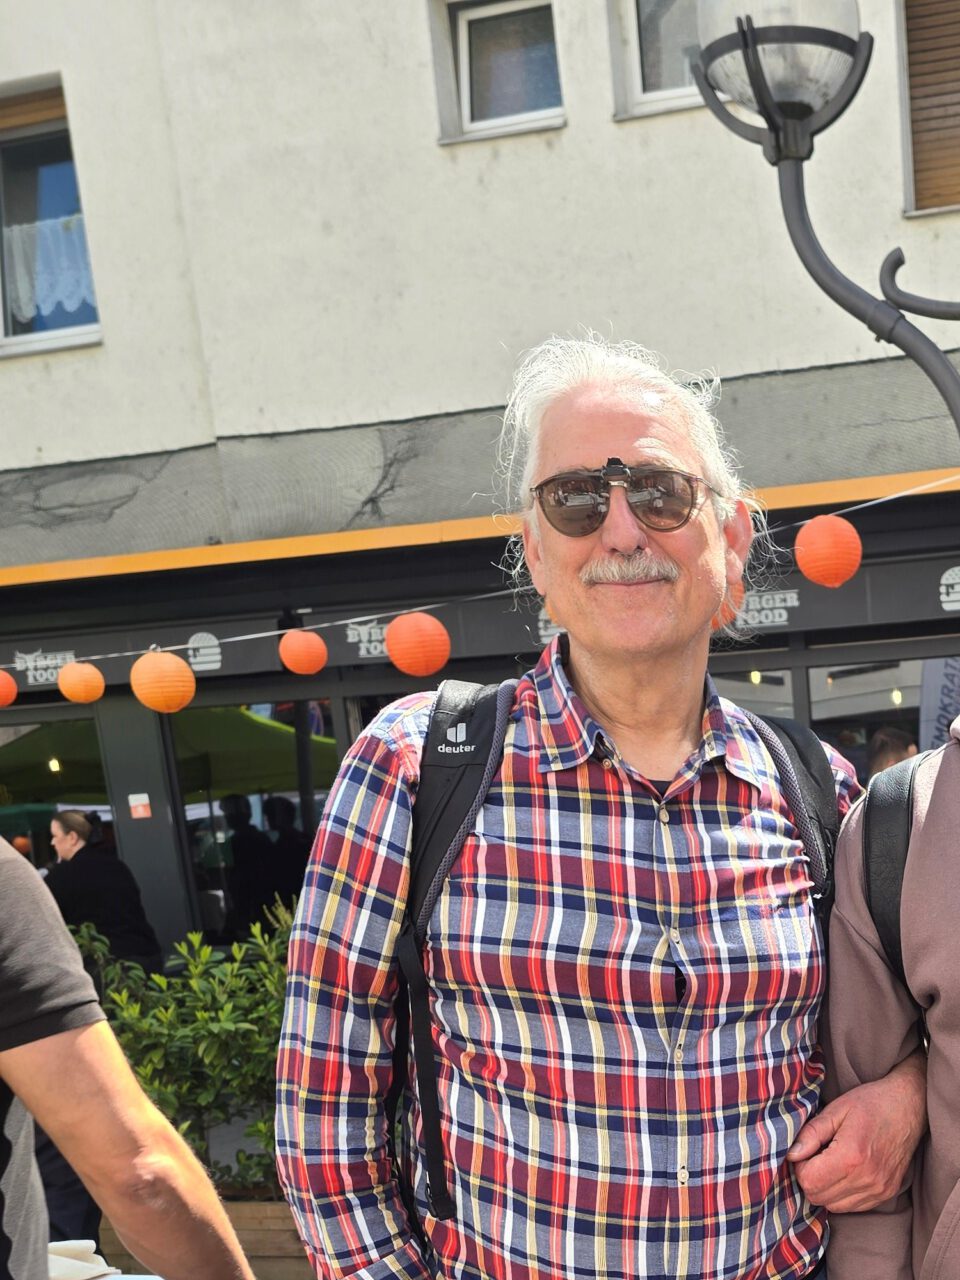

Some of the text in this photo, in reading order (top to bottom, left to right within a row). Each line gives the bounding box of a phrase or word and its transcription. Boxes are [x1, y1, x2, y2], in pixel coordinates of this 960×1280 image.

[748, 592, 800, 610] RGER
[346, 620, 388, 643] BUR
[27, 667, 61, 684] FOO
[437, 743, 476, 754] deuter
